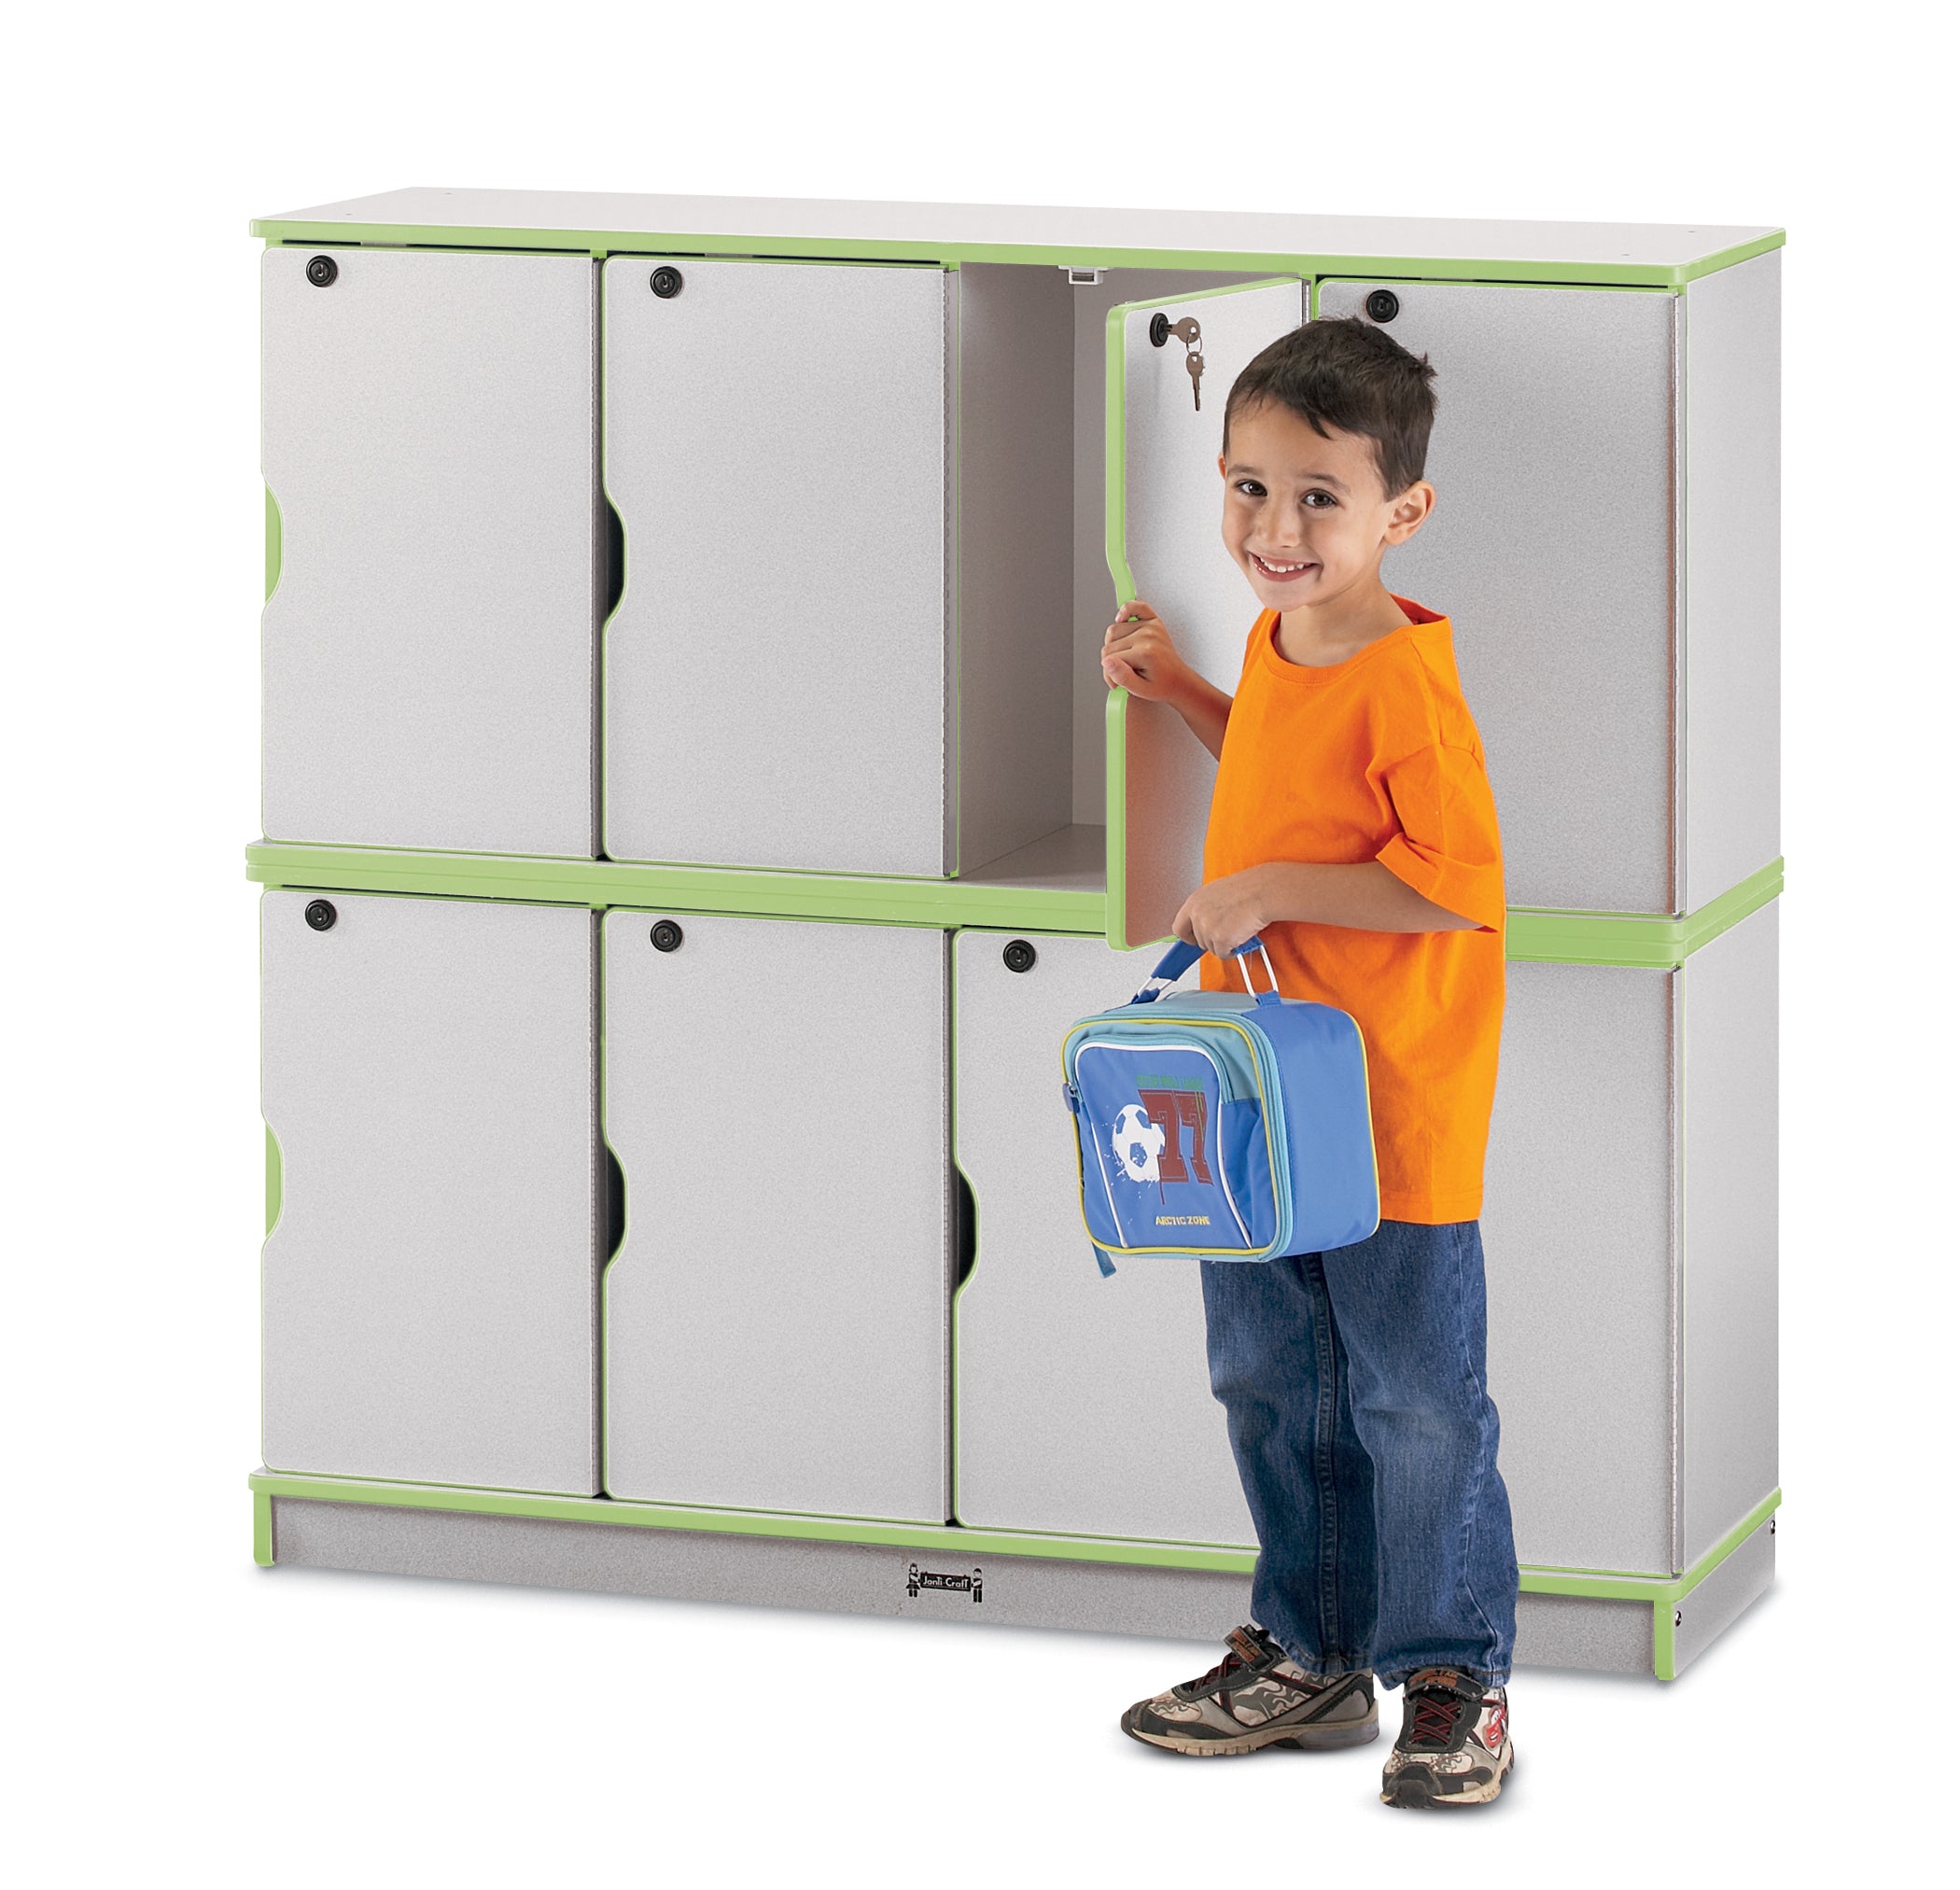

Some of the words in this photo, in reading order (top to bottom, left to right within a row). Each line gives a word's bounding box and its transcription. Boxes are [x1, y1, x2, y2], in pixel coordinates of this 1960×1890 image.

[1139, 1089, 1213, 1185] 77
[1155, 1215, 1186, 1225] ARCTIC
[1187, 1215, 1211, 1225] ZONE
